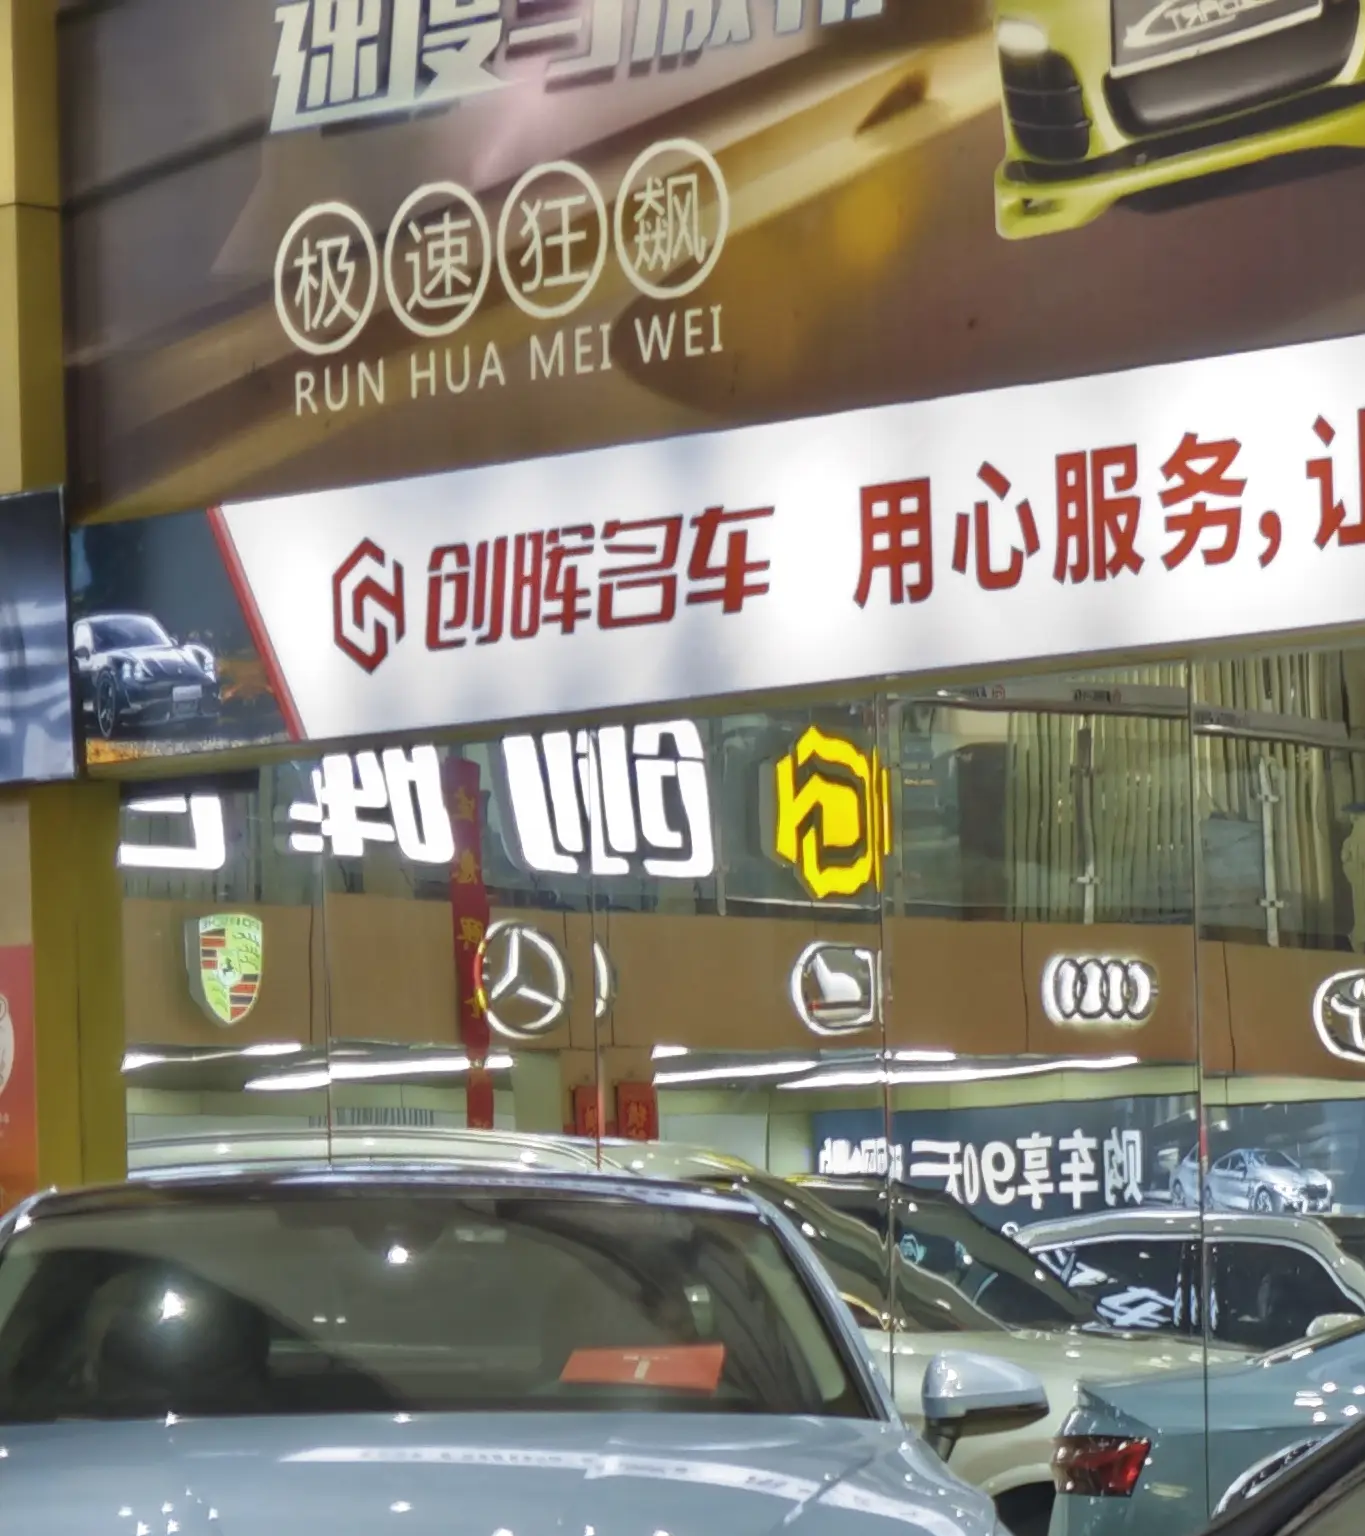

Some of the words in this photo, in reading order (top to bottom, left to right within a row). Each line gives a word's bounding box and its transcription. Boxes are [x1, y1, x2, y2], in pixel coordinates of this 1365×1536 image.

[293, 172, 707, 334] 极速狂飙
[293, 357, 387, 416] RUN
[410, 342, 507, 398] HUA
[529, 323, 613, 380] MEI
[634, 303, 725, 364] WEI
[425, 503, 776, 651] 创晖名车
